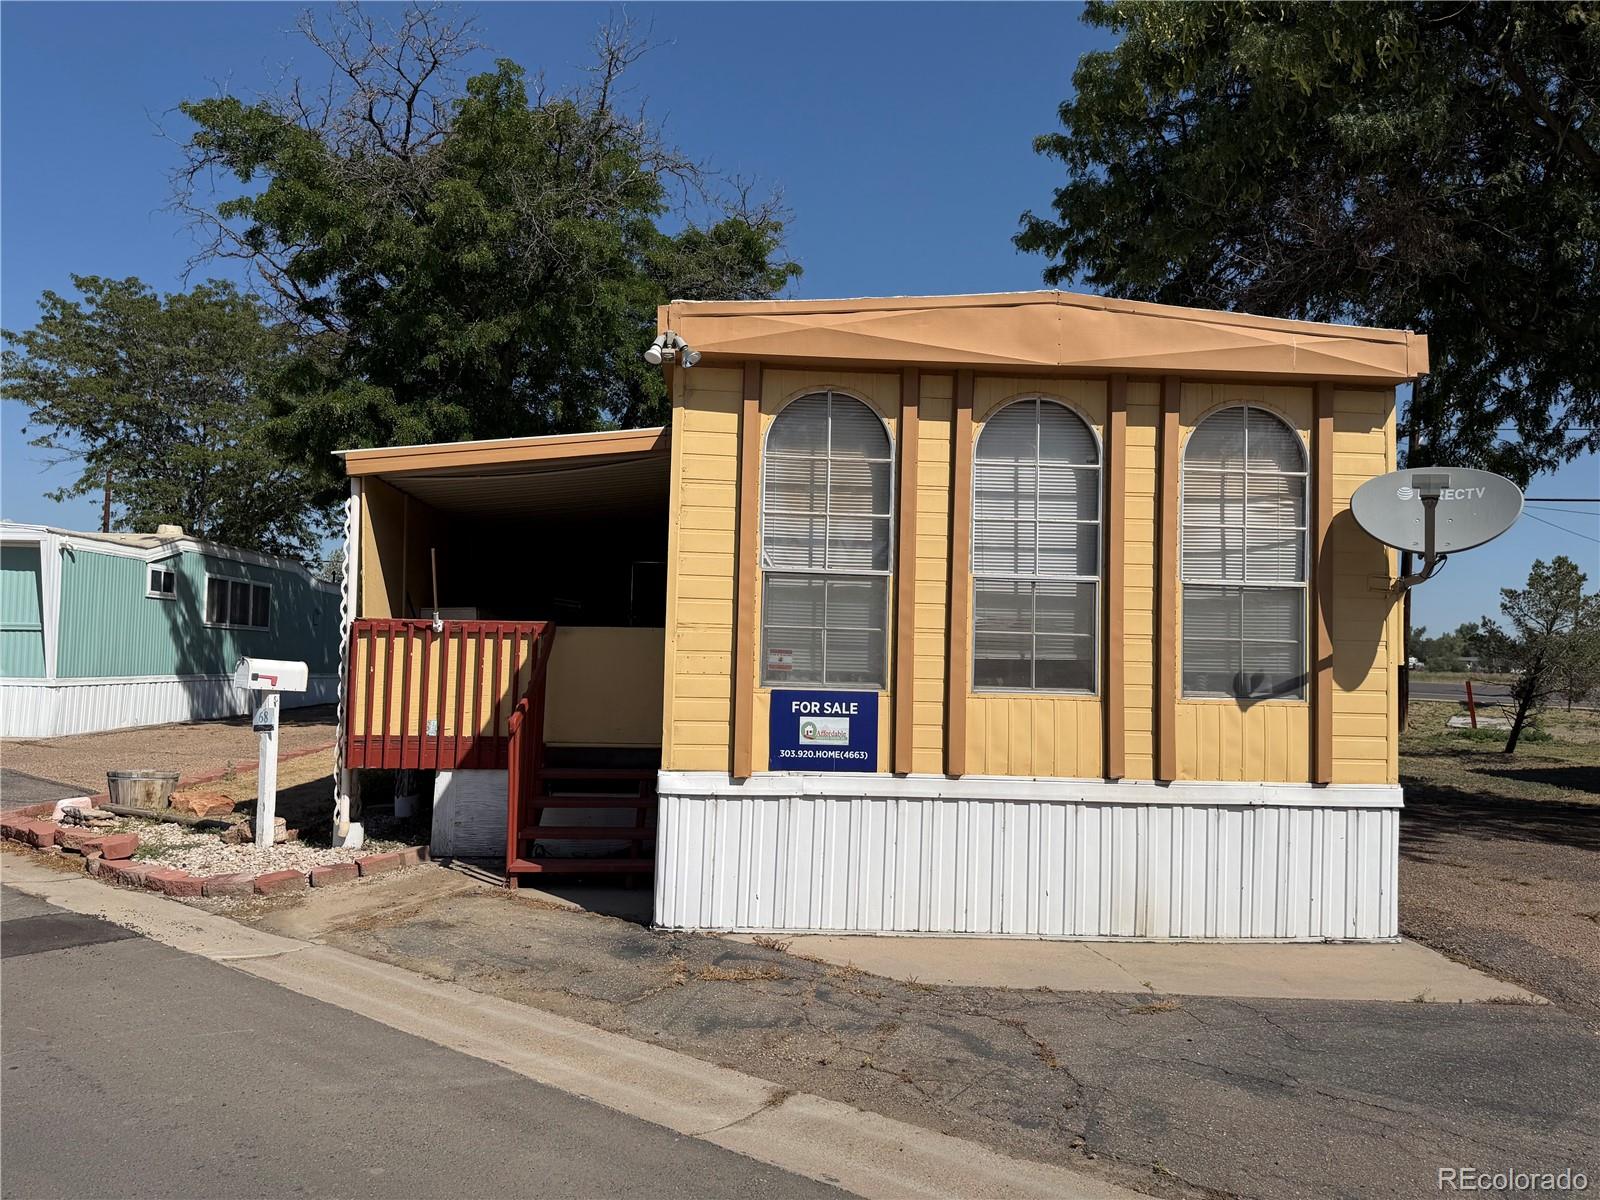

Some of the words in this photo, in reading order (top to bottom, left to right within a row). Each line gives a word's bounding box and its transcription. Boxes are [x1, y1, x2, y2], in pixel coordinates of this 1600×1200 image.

[1417, 487, 1486, 500] RECTV
[791, 701, 820, 714] FOR
[823, 702, 858, 715] SALE
[258, 710, 269, 723] 68
[779, 749, 868, 760] 303.920.HOME(4663)
